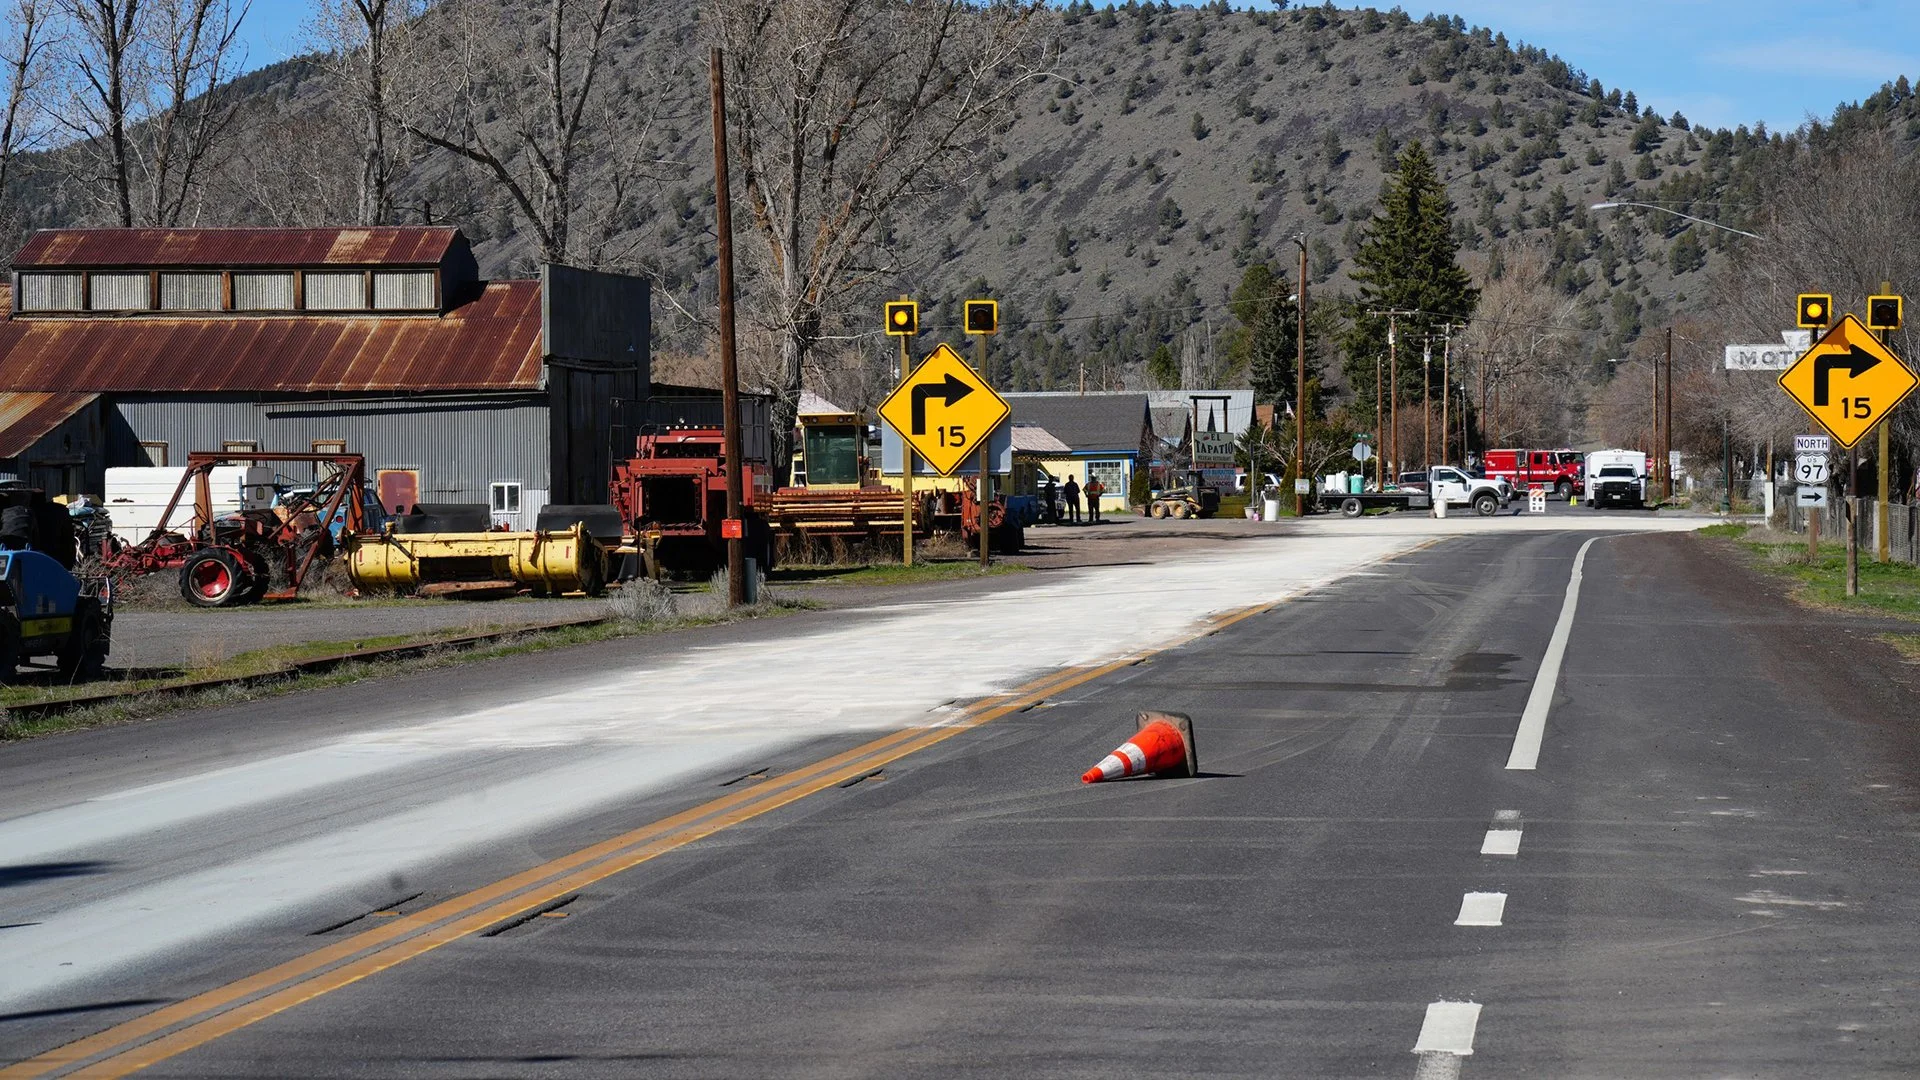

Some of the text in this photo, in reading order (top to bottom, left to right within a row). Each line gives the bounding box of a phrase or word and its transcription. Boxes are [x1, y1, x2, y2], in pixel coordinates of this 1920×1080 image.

[1841, 397, 1872, 419] 15
[937, 426, 966, 447] 15
[1211, 433, 1221, 441] EL
[1797, 438, 1828, 449] NORTH
[1196, 440, 1234, 454] TAPATIO
[1801, 464, 1823, 479] 97
